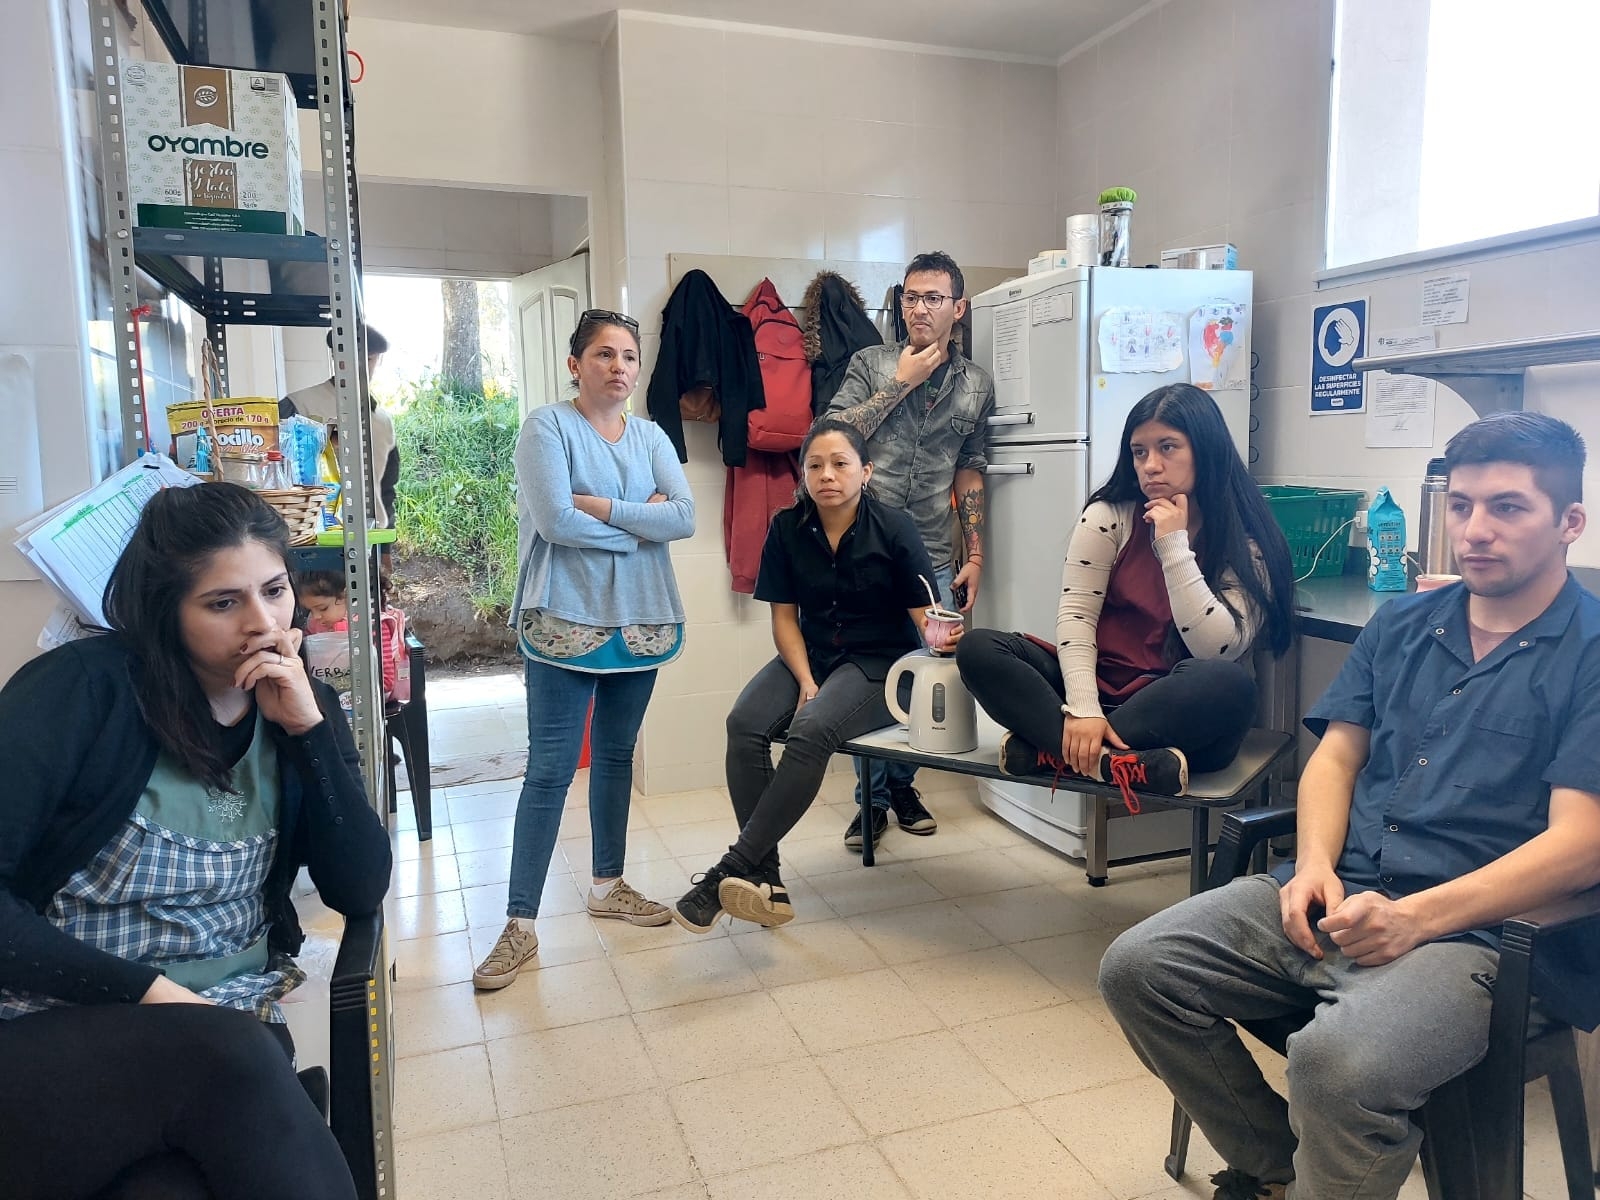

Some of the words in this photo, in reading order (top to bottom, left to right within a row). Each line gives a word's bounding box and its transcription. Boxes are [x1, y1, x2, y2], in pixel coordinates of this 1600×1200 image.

[1319, 373, 1357, 382] DESINFECTAR
[1326, 380, 1361, 390] SUPERFICIES
[1315, 388, 1360, 397] REGULARMENTE
[182, 421, 198, 430] 200
[245, 414, 262, 423] 170
